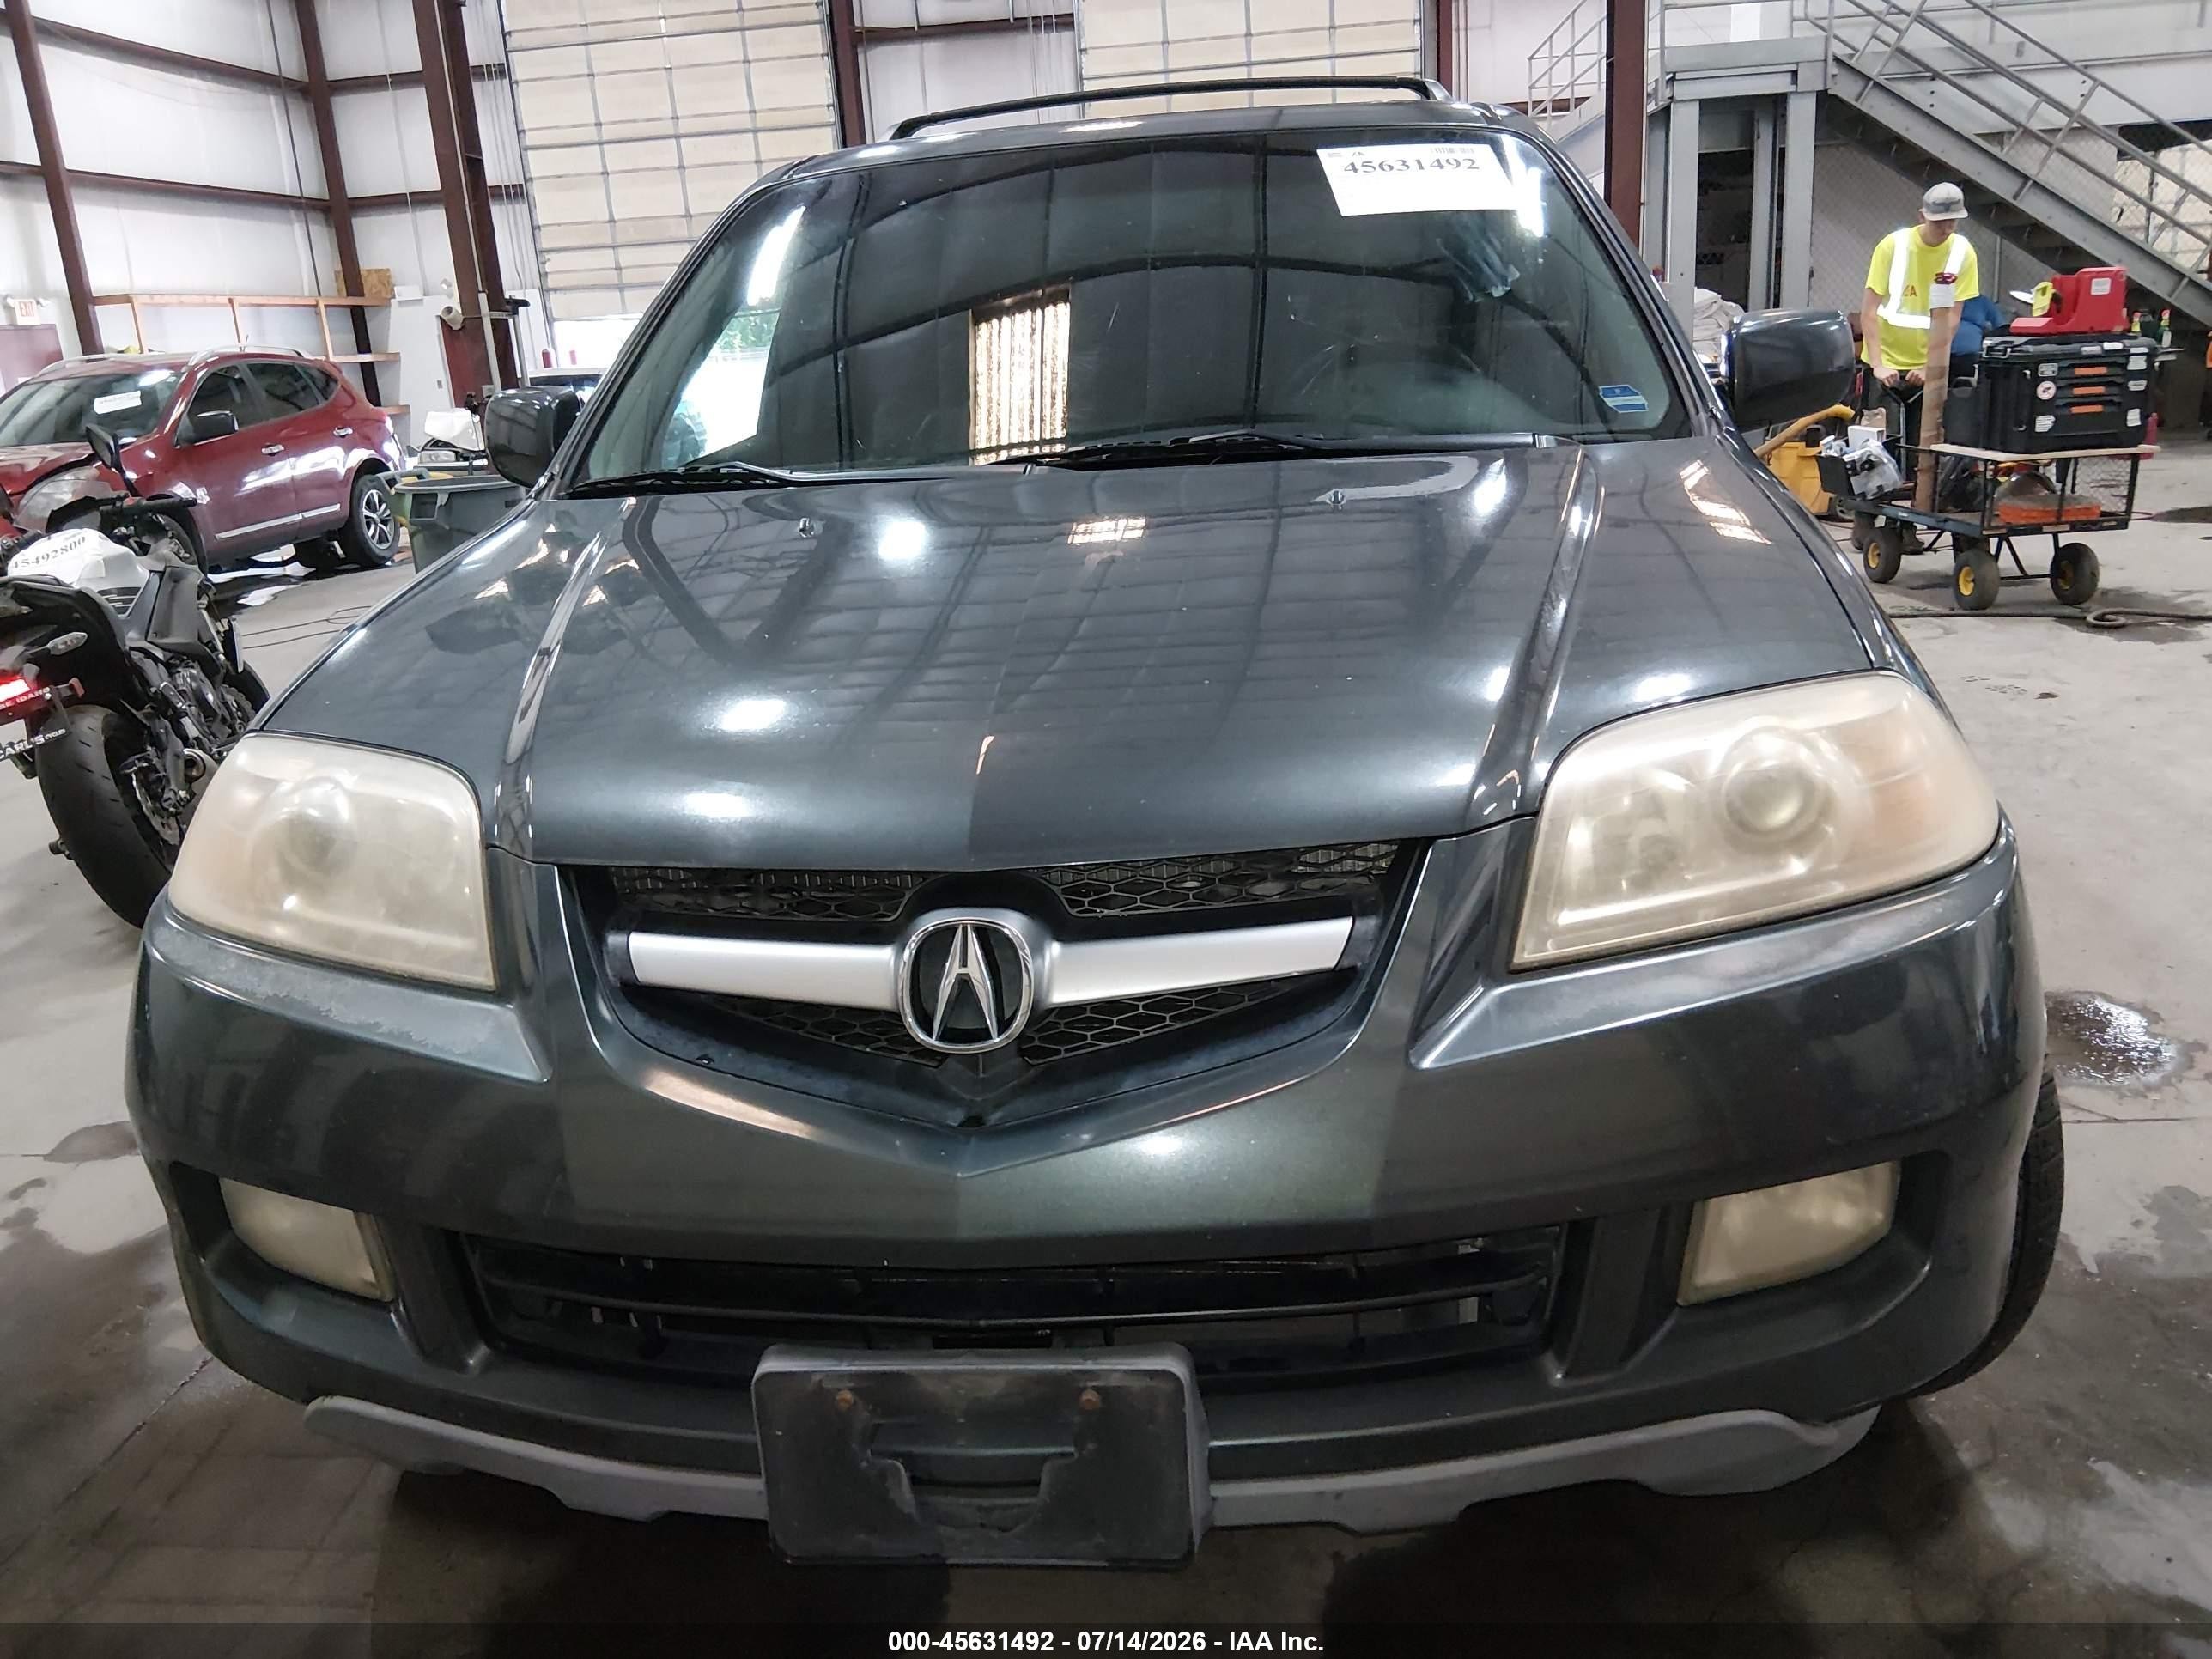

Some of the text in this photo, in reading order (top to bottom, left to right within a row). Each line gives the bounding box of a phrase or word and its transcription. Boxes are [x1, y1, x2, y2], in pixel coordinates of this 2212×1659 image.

[1343, 157, 1480, 173] 45631492
[18, 301, 35, 317] EXIT
[15, 686, 51, 703] IDAHO
